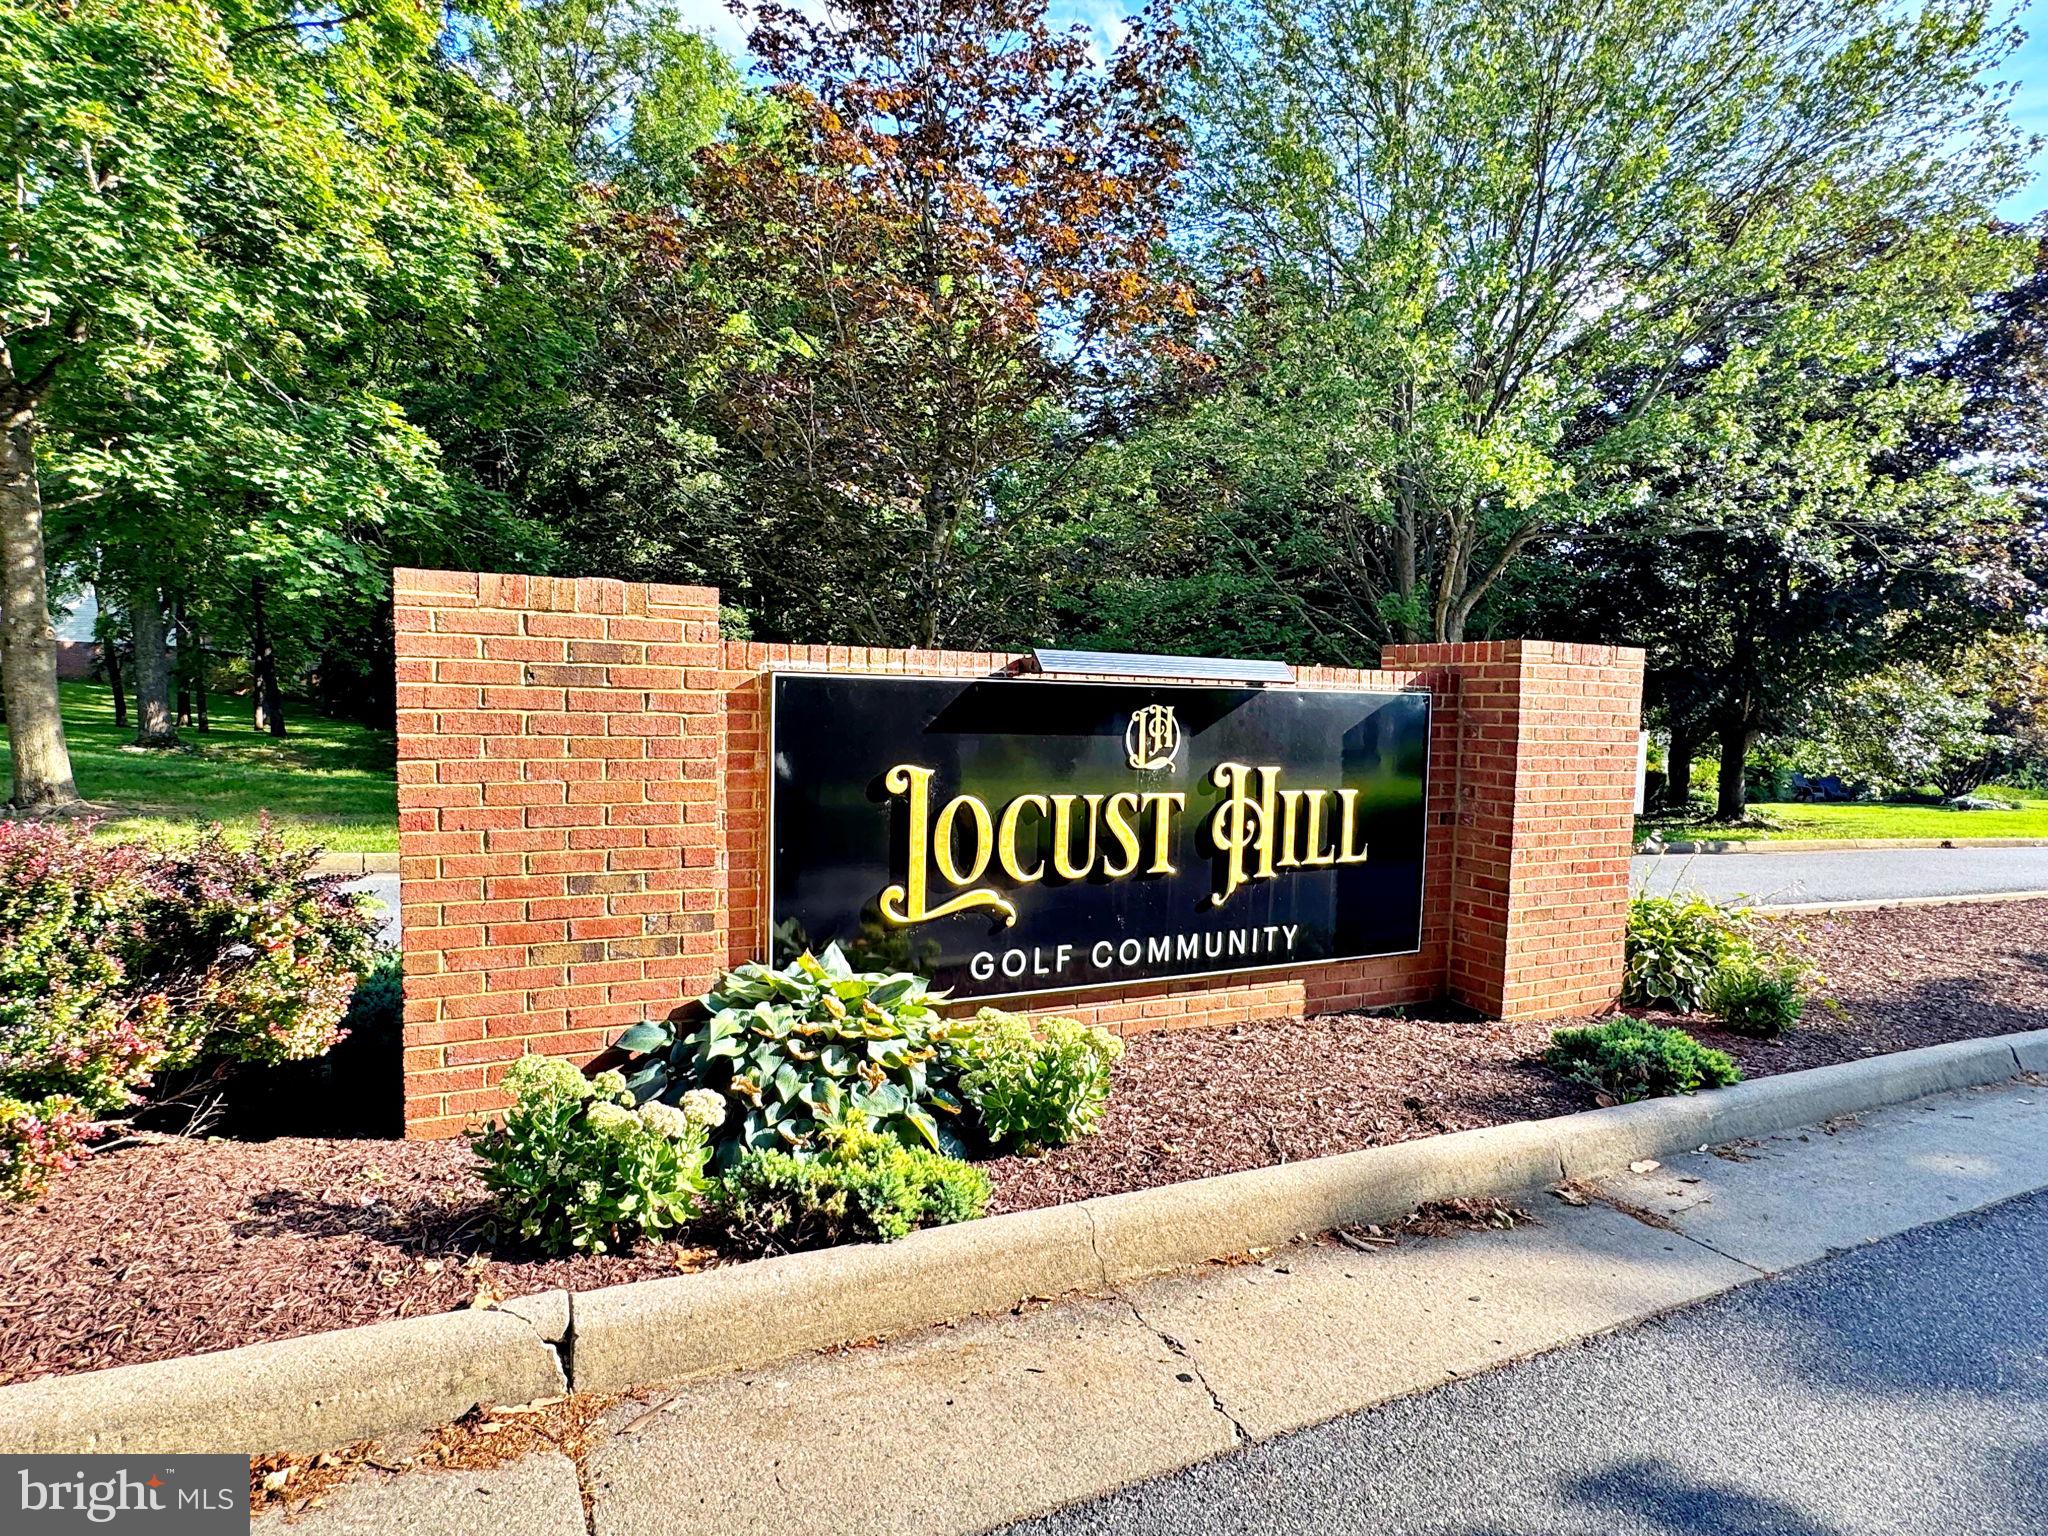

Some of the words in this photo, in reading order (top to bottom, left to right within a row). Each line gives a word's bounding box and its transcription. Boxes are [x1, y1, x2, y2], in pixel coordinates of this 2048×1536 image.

[879, 764, 1186, 928] LOCUST
[1211, 762, 1369, 907] HILL
[970, 943, 1072, 981] GOLF
[1092, 924, 1299, 969] COMMUNITY
